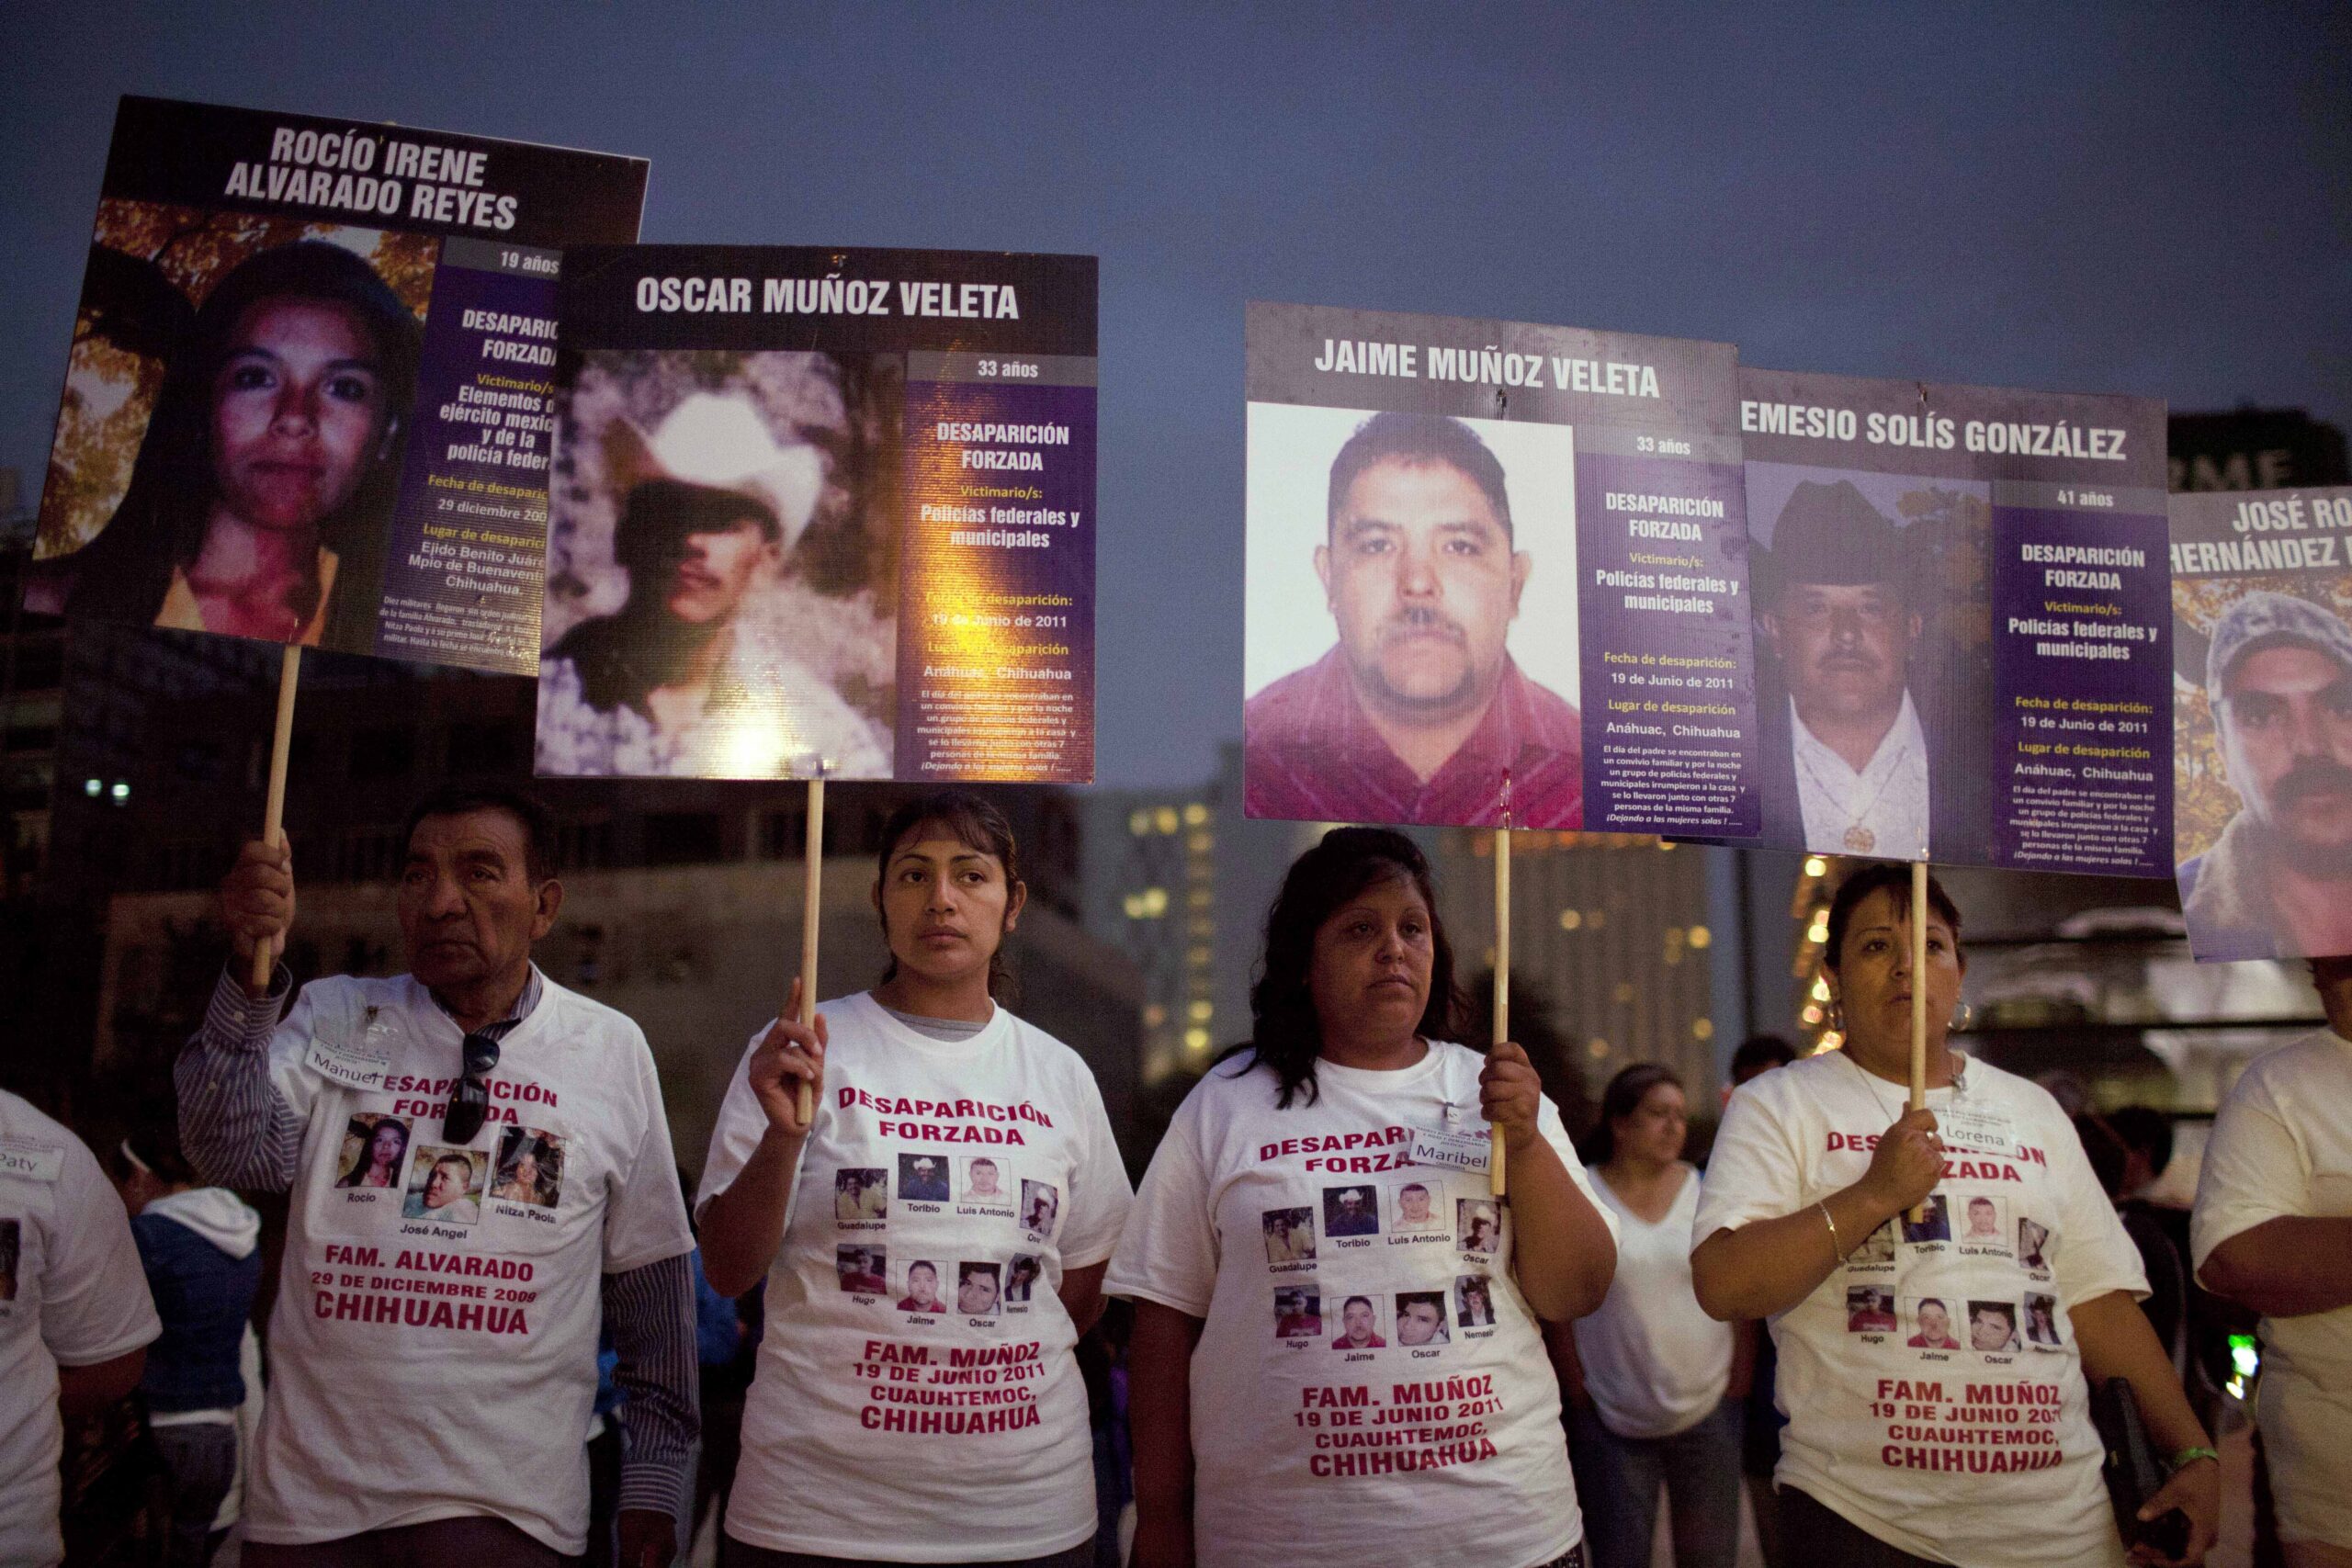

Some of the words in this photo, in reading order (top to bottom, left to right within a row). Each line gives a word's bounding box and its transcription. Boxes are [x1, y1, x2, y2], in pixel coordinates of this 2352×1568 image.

[270, 128, 376, 172] ROCÍO
[384, 141, 488, 186] IRENE
[224, 162, 401, 214] ALVARADO
[411, 184, 517, 231] REYES
[501, 251, 518, 268] 19
[523, 254, 560, 274] años
[637, 276, 751, 313] OSCAR
[763, 273, 888, 315] MUÑOZ
[901, 282, 1019, 320] VELETA
[978, 360, 997, 377] 33
[1002, 361, 1038, 378] años
[1315, 339, 1417, 378] JAIME
[1429, 345, 1543, 388] MUÑOZ
[1553, 357, 1659, 399] VELETA
[458, 386, 541, 412] Elementos
[482, 429, 492, 445] y
[495, 429, 515, 446] de
[519, 431, 536, 448] la
[937, 423, 1069, 445] DESAPARICIÓN
[1866, 411, 1955, 450] SOLÍS
[1965, 420, 2127, 460] GONZÁLEZ
[447, 445, 503, 465] policía
[1637, 436, 1654, 451] 33
[1658, 438, 1690, 455] años
[962, 451, 1043, 471] FORZADA
[960, 485, 1042, 500] Victimario/s:
[2057, 490, 2075, 504] 41
[2079, 491, 2114, 506] años
[1606, 492, 1724, 518] DESAPARICIÓN
[2233, 494, 2308, 533] JOSÉ
[921, 504, 985, 523] Policías
[990, 507, 1066, 525] federales
[1071, 511, 1080, 528] y
[950, 529, 1049, 548] municipales
[1629, 520, 1702, 541] FORZADA
[1629, 553, 1703, 568] Victimario/s:
[2021, 544, 2145, 568] DESAPARICIÓN
[2170, 535, 2340, 573] HERNÁNDEZ
[1596, 570, 1655, 589] Policías
[1659, 574, 1726, 593] federales
[1731, 581, 1739, 596] y
[2045, 570, 2121, 591] FORZADA
[1624, 594, 1713, 614] municipales
[2044, 602, 2121, 616] Victimario/s:
[973, 615, 1010, 626] Junio
[1014, 615, 1031, 626] de
[1035, 616, 1067, 627] 2011
[2008, 617, 2069, 637] Policías
[2074, 621, 2144, 640] federales
[2148, 627, 2157, 642] y
[1604, 652, 1637, 664] Fecha
[1642, 653, 1656, 665] de
[1659, 655, 1736, 669] desaparición:
[2036, 641, 2130, 660] municipales
[1611, 673, 1626, 683] 19
[1629, 674, 1645, 684] de
[1648, 675, 1683, 686] Junio
[1686, 677, 1702, 687] de
[1705, 678, 1734, 689] 2011
[1608, 699, 1641, 712] Lugar
[1644, 700, 1658, 712] de
[1662, 702, 1736, 715] desaparición
[2016, 696, 2050, 708] Fecha
[2053, 698, 2068, 709] de
[2072, 699, 2153, 714] desaparición:
[1607, 722, 1667, 736] Anáhuac,
[1672, 725, 1741, 739] Chihuahua
[2020, 716, 2036, 728] 19
[2040, 717, 2055, 728] de
[2059, 718, 2095, 731] Junio
[2098, 720, 2114, 731] de
[2118, 722, 2148, 733] 2011
[1603, 745, 1611, 753] El
[1612, 746, 1626, 754] día
[1642, 748, 1666, 757] padre
[1679, 750, 1729, 758] encontraban
[2018, 741, 2051, 755] Lugar
[2054, 743, 2069, 754] de
[2073, 744, 2150, 759] desaparición
[2014, 763, 2076, 778] Anáhuac,
[2082, 767, 2154, 782] Chihuahua
[839, 1087, 1054, 1128] DESAPARICIÓN
[879, 1121, 1025, 1146] FORZADA
[1946, 1125, 2005, 1146] Lorena
[1417, 1145, 1487, 1168] Maribel
[496, 1204, 525, 1218] Nitza
[527, 1210, 557, 1224] Paola
[956, 1205, 978, 1215] Luis
[979, 1207, 1015, 1218] Antonio
[401, 1224, 429, 1235] José
[432, 1228, 468, 1240] Angel
[838, 1222, 887, 1232] Guadalupe
[1388, 1235, 1409, 1246] Luis
[1413, 1234, 1451, 1244] Antonio
[325, 1244, 385, 1268] FAM.
[395, 1250, 534, 1282] ALVARADO
[1463, 1254, 1488, 1265] Oscar
[1959, 1247, 1979, 1256] Luis
[1982, 1248, 2014, 1259] Antonio
[1269, 1262, 1317, 1274] Guadalupe
[311, 1271, 334, 1285] 29
[340, 1274, 364, 1288] DE
[370, 1277, 487, 1299] DICIEMBRE
[494, 1288, 537, 1303] 2009
[853, 1294, 876, 1305] Hugo
[315, 1291, 528, 1335] CHIHUAHUA
[907, 1314, 935, 1325] Jaime
[969, 1318, 996, 1327] Oscar
[1286, 1339, 1308, 1349] Hugo
[1860, 1335, 1884, 1344] Hugo
[865, 1340, 937, 1366] FAM.
[950, 1342, 1041, 1368] MUÑOZ
[1344, 1352, 1374, 1362] Jaime
[1412, 1348, 1441, 1359] Oscar
[1919, 1352, 1950, 1361] Jaime
[1984, 1355, 2013, 1365] Oscar
[853, 1362, 880, 1379] 19
[889, 1366, 920, 1382] DE
[927, 1369, 997, 1384] JUNIO
[1002, 1363, 1046, 1382] 2011
[871, 1385, 1036, 1406] CUAUHTEMOC,
[1303, 1386, 1380, 1407] FAM.
[1393, 1374, 1492, 1405] MUÑOZ
[1877, 1379, 1953, 1403] FAM.
[1965, 1381, 2062, 1405] MUÑOZ
[861, 1404, 1041, 1435] CHIHUAHUA
[1295, 1412, 1320, 1427] 19
[1331, 1411, 1362, 1426] DE
[1372, 1405, 1449, 1425] JUNIO
[1458, 1396, 1503, 1417] 2011
[1316, 1421, 1487, 1449] CUAUHTEMOC,
[1888, 1425, 2059, 1447] CUAUHTEMOC,
[1310, 1438, 1498, 1477] CHIHUAHUA
[1882, 1445, 2063, 1474] CHIHUAHUA
